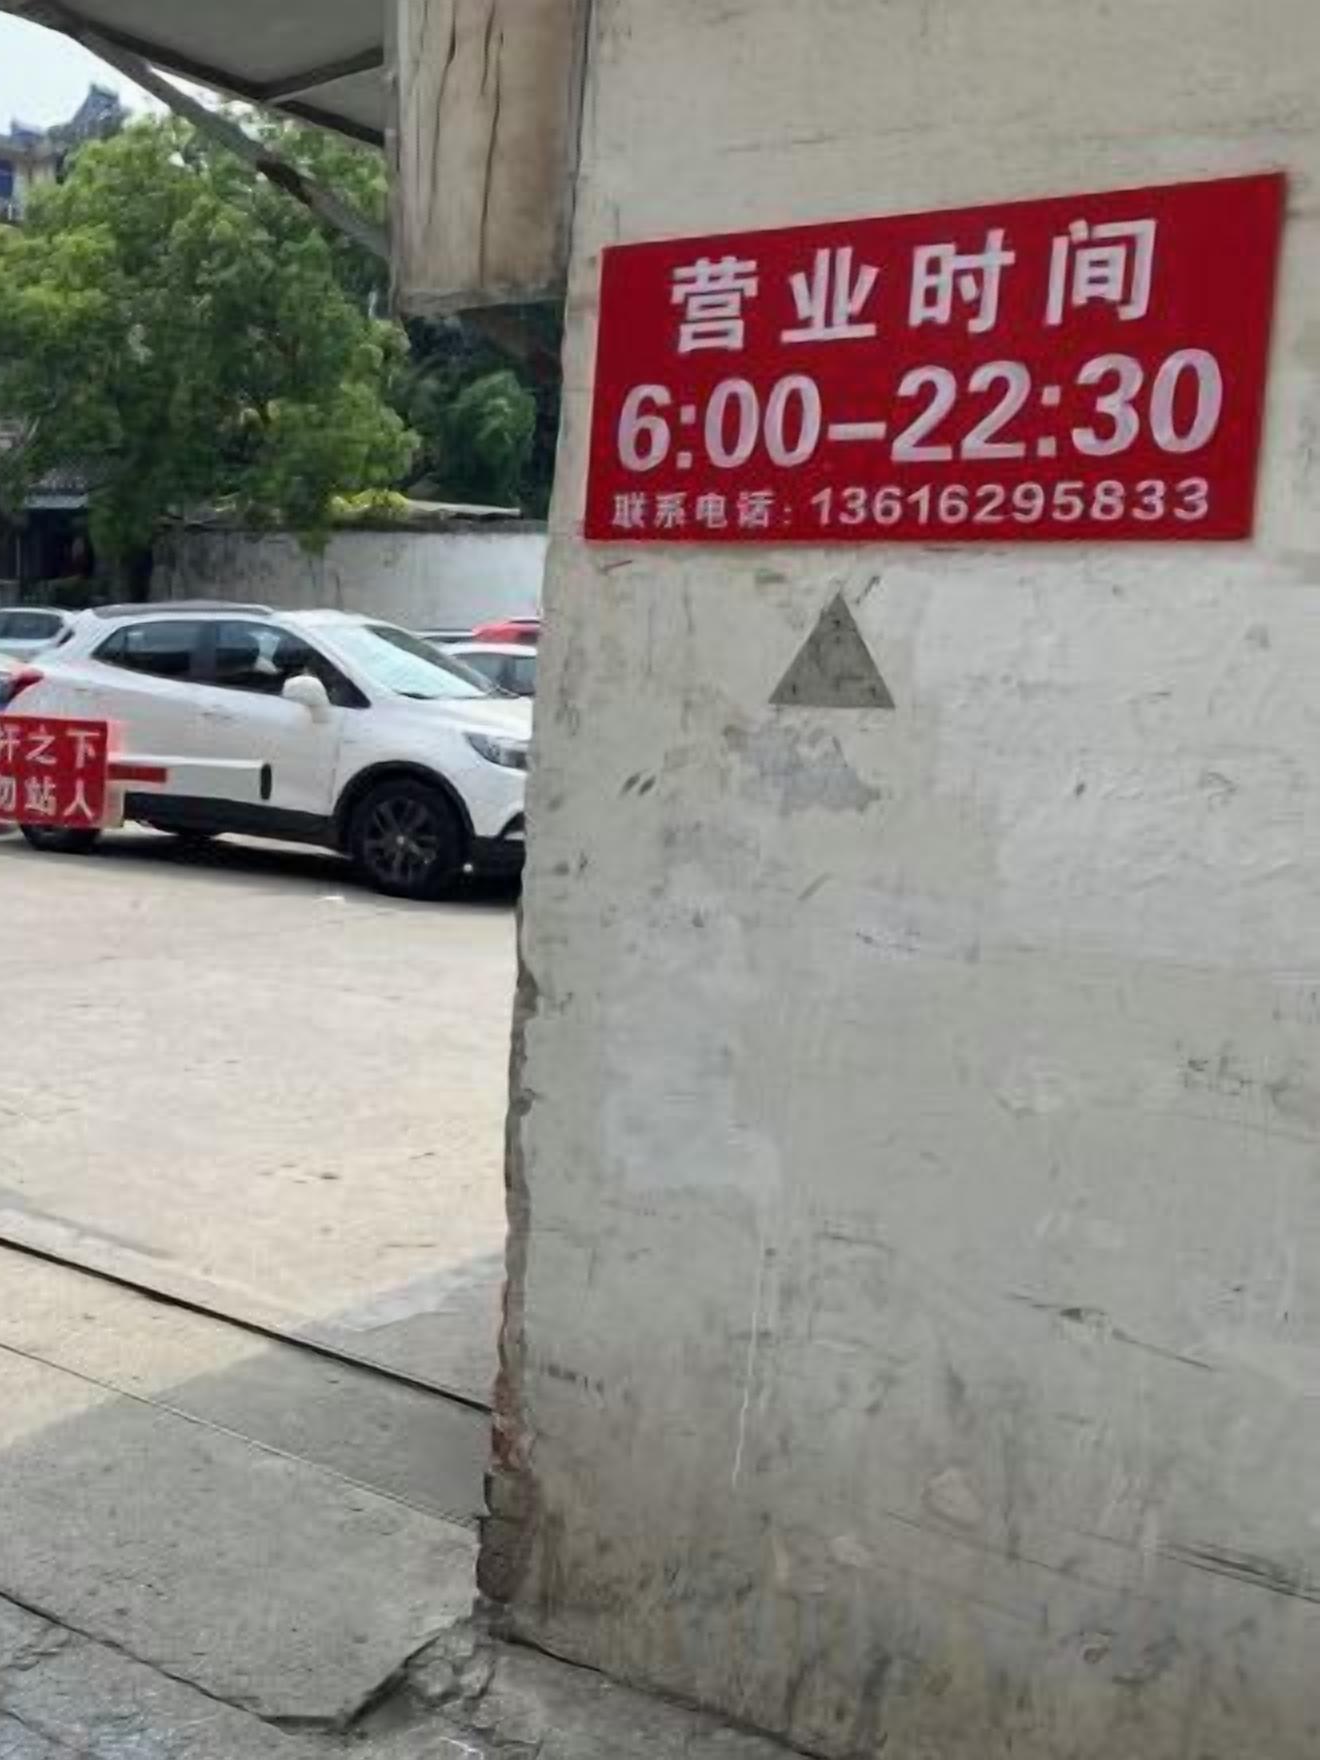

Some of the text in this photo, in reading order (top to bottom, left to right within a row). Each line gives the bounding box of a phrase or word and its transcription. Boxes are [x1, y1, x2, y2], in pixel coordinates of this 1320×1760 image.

[671, 218, 1156, 353] 营业时间
[617, 348, 1223, 471] 6:00-22:30
[811, 477, 1209, 526] 13616295833
